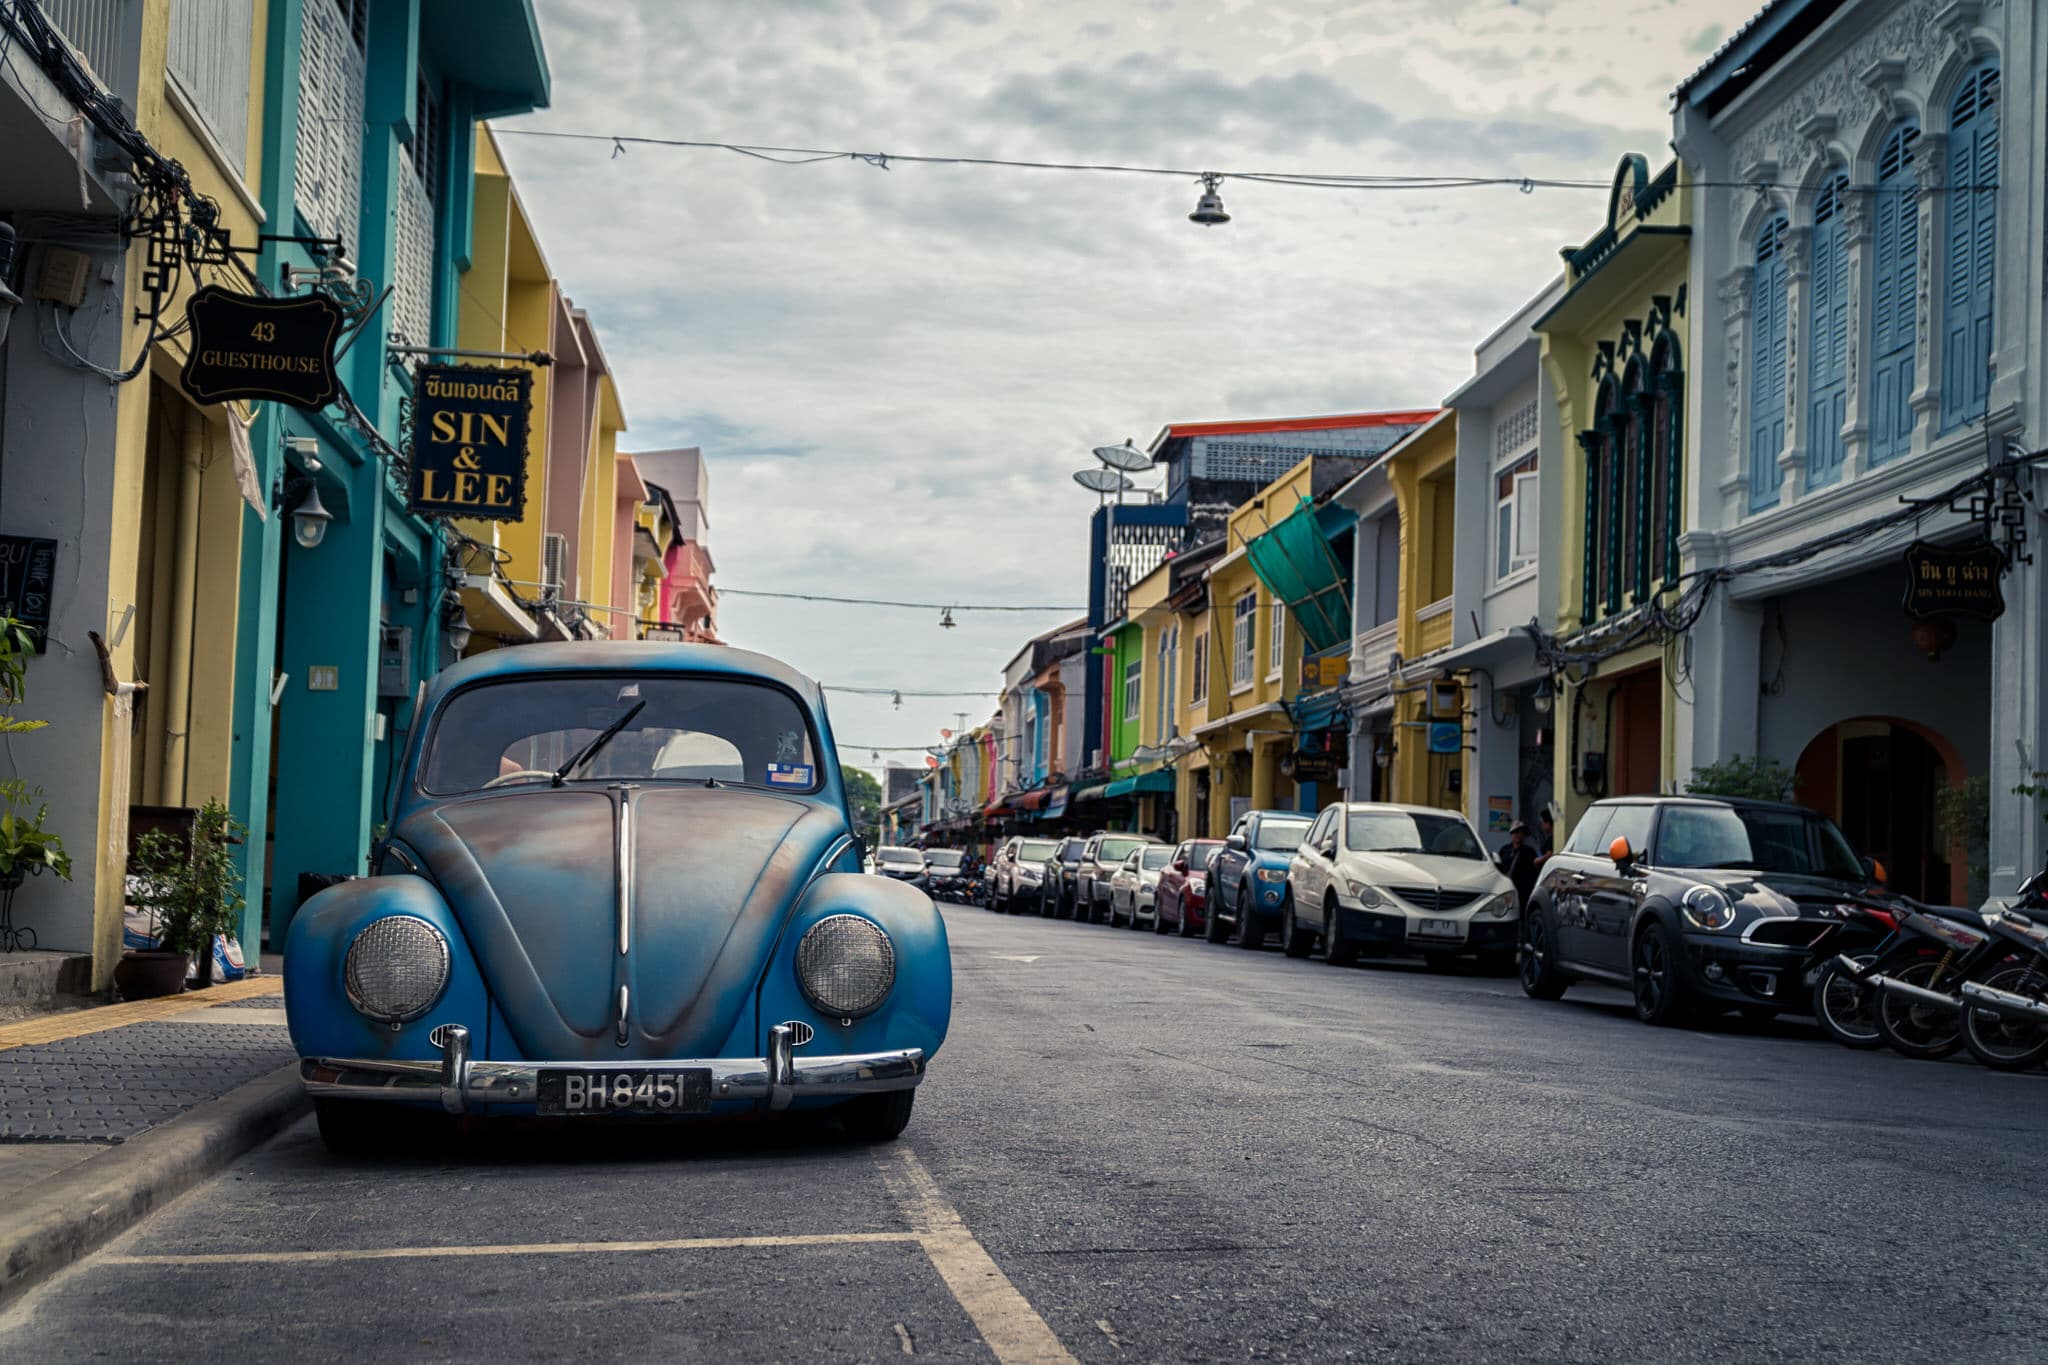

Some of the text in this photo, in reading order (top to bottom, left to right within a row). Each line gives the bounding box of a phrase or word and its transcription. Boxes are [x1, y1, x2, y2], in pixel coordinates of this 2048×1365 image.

[251, 321, 277, 343] 43
[202, 349, 321, 375] GUESTHOUSE
[431, 410, 513, 447] SIN
[452, 446, 481, 470] &
[418, 469, 512, 507] LEE
